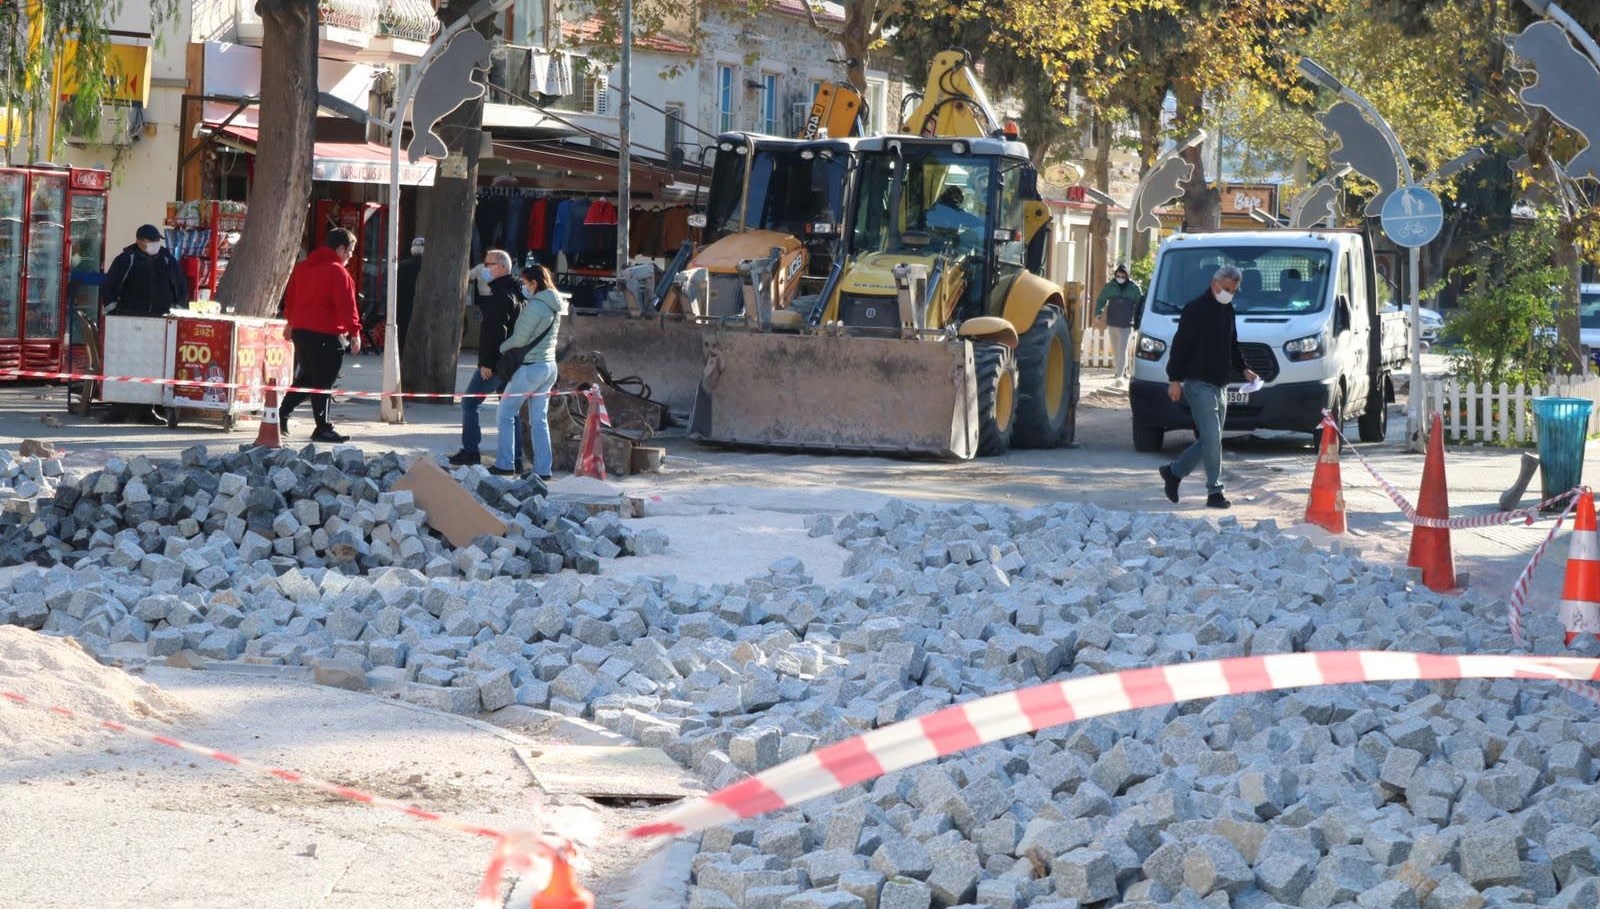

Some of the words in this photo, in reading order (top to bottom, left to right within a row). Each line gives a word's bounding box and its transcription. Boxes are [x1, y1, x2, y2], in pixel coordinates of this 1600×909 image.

[179, 345, 211, 364] 100
[238, 348, 256, 367] 100
[266, 347, 284, 366] 100
